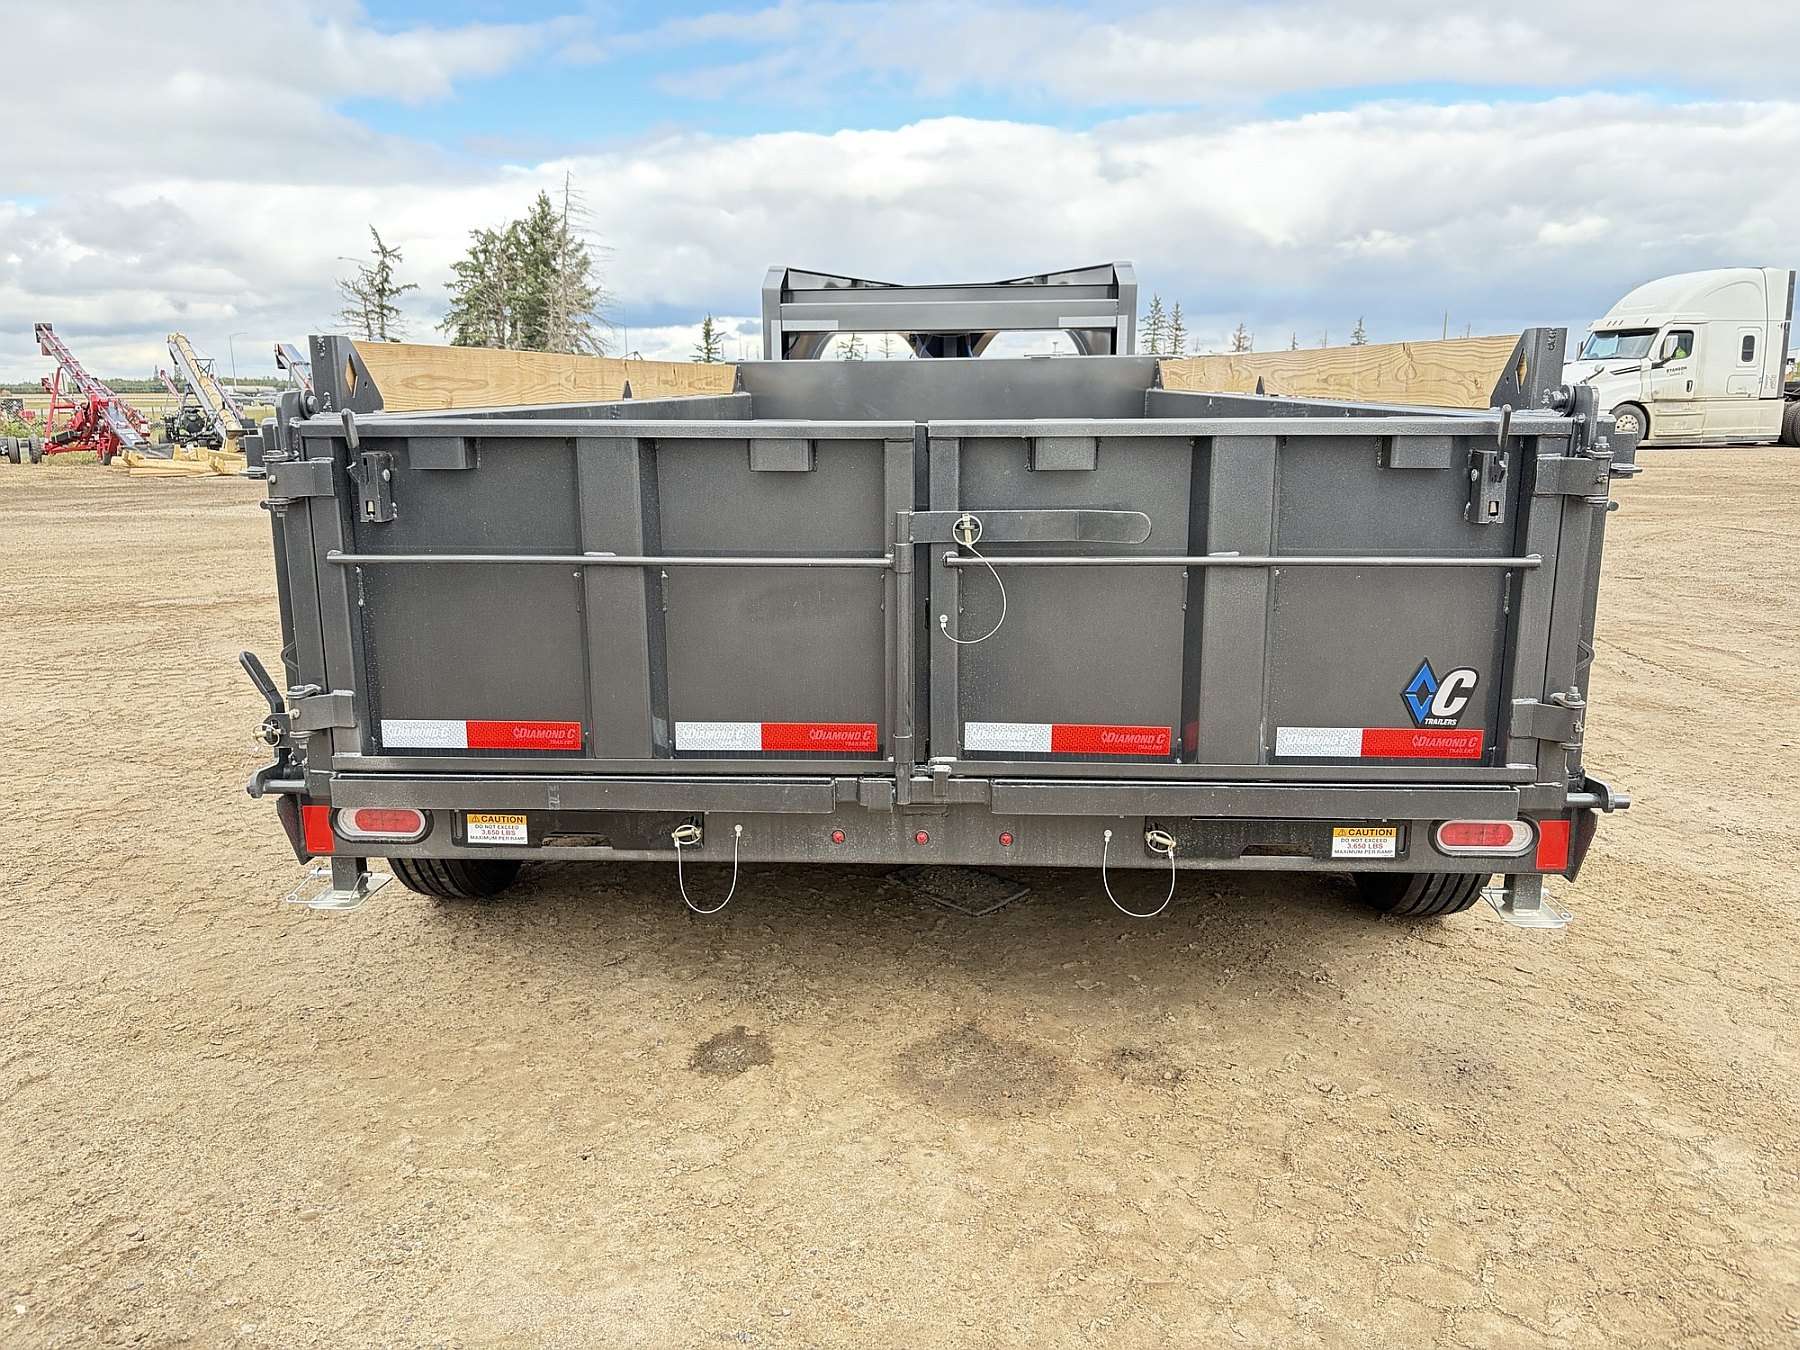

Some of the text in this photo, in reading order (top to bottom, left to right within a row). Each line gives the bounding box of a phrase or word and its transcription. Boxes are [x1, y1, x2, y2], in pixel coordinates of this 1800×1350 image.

[1431, 669, 1477, 717] C
[1424, 718, 1457, 726] TRAILERS
[519, 728, 576, 739] DIAMOND C
[816, 729, 872, 741] DIAMOND C
[1107, 732, 1167, 745] DIAMOND C
[1419, 736, 1479, 748] DIAMOND C
[481, 815, 523, 823] CAUTION
[1348, 828, 1393, 836] CAUTION
